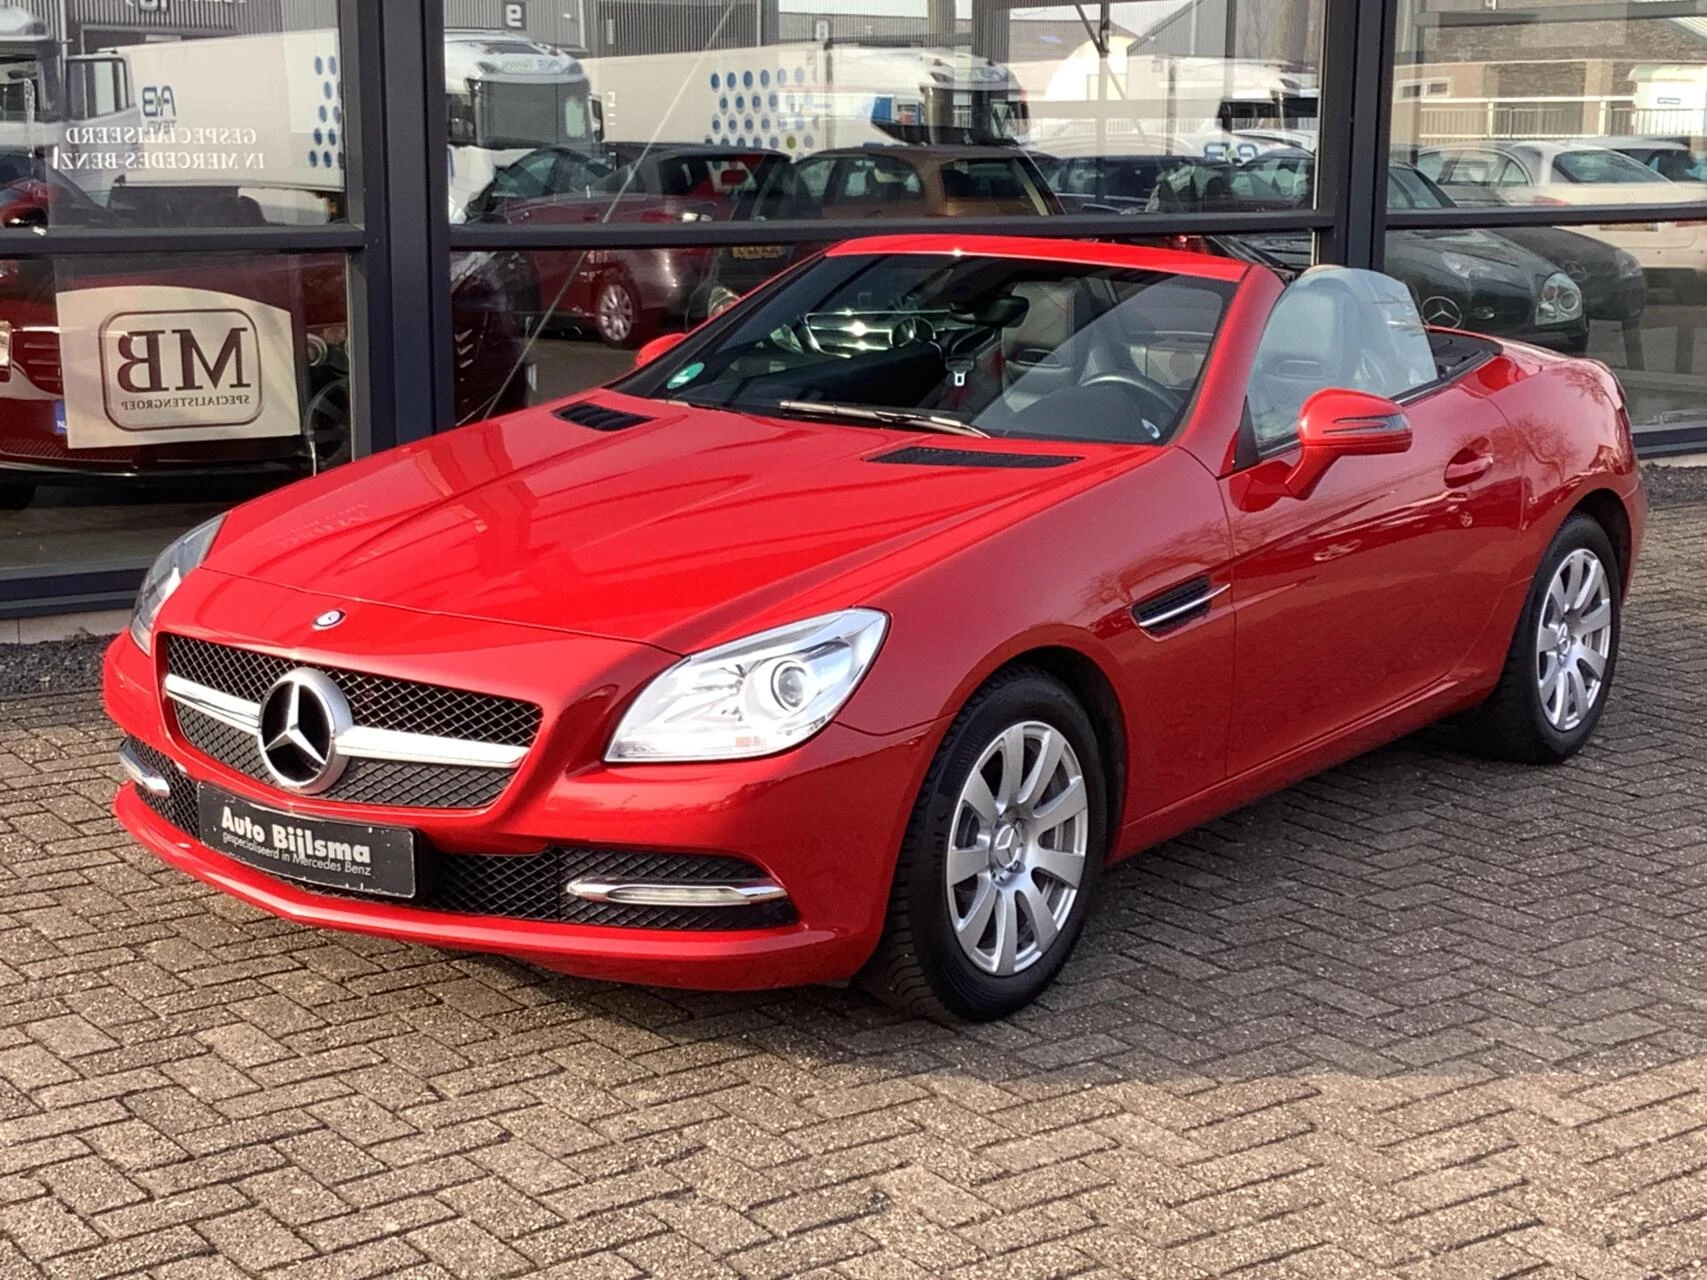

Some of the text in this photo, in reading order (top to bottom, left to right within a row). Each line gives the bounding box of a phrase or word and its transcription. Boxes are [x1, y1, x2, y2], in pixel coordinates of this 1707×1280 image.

[221, 806, 371, 864] Auto Bijlsma
[222, 832, 372, 876] gespecialiseerd in Mercedes Benz
